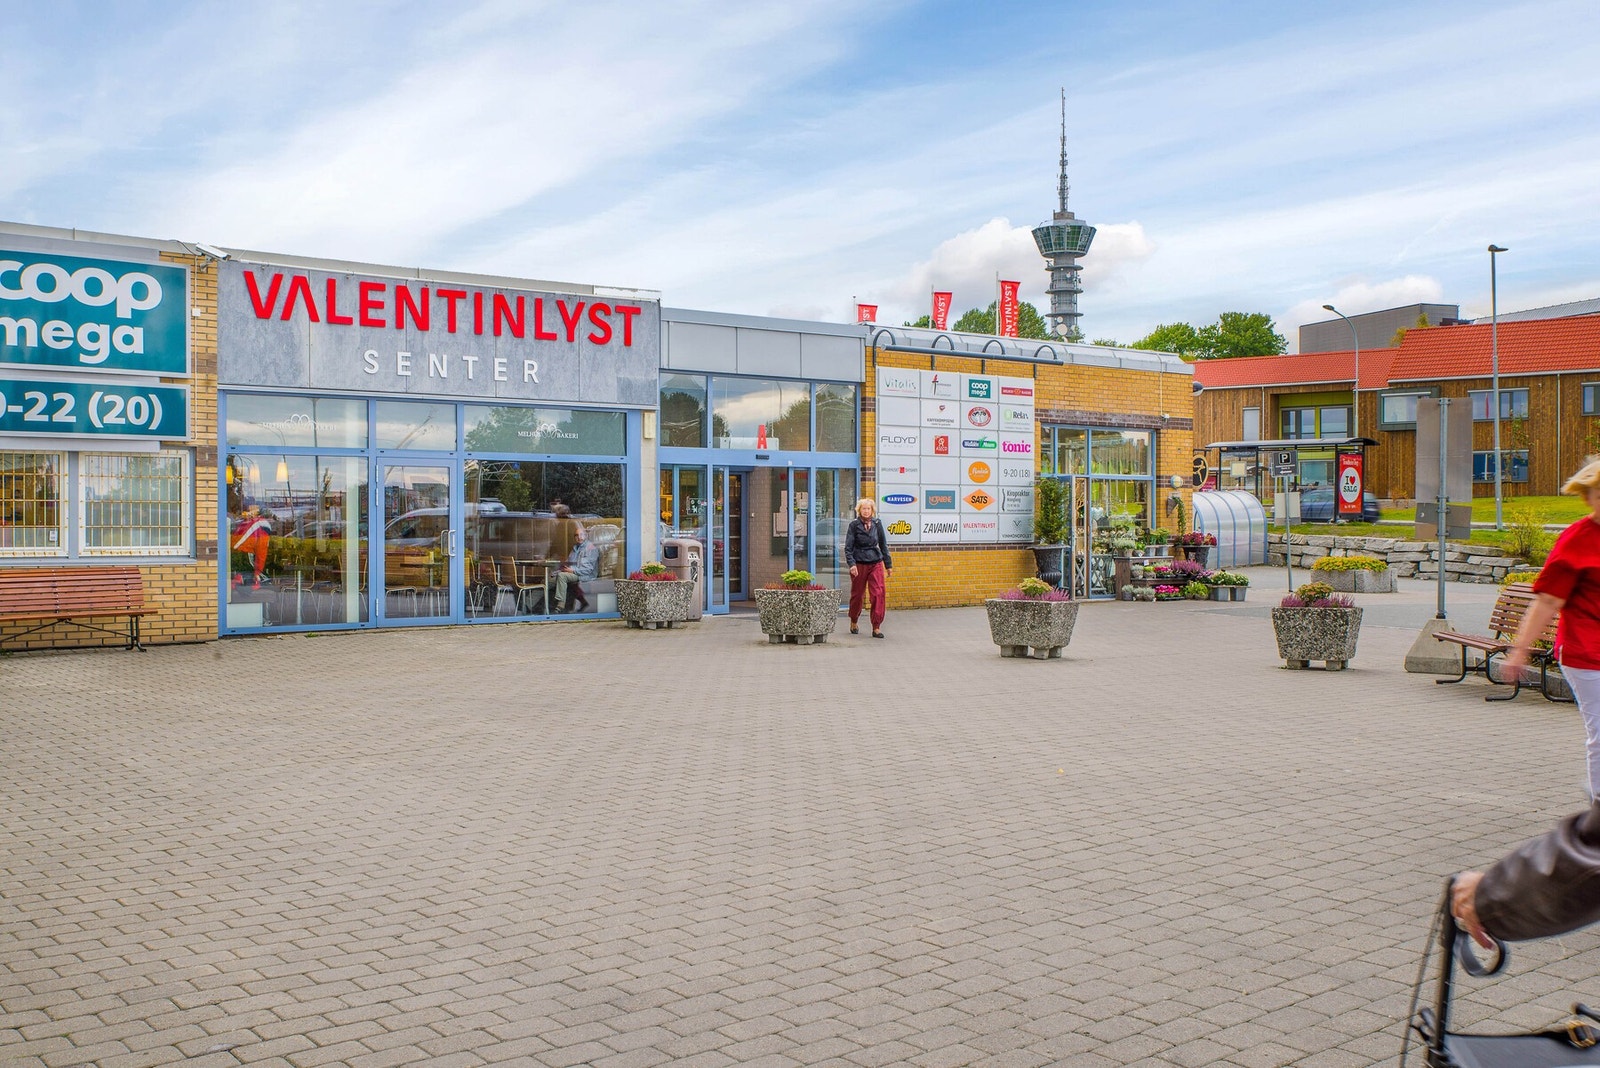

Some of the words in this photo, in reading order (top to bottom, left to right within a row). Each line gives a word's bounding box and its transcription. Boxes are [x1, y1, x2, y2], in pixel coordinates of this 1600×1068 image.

[0, 260, 163, 319] coop
[243, 271, 641, 347] VALENTINLYST
[937, 296, 945, 330] INLYST
[0, 316, 144, 364] mega
[363, 349, 539, 384] SENTER
[971, 382, 988, 391] coop
[971, 389, 986, 397] mega
[88, 391, 163, 430] (20)
[881, 436, 917, 444] FLOYD
[1002, 440, 1032, 453] tonic
[1281, 454, 1289, 463] P
[1003, 468, 1018, 478] 9-20
[1018, 469, 1031, 479] (18)
[1345, 475, 1349, 484] I
[970, 495, 988, 504] SATS
[889, 520, 912, 534] nille
[923, 523, 958, 534] ZAVANNA
